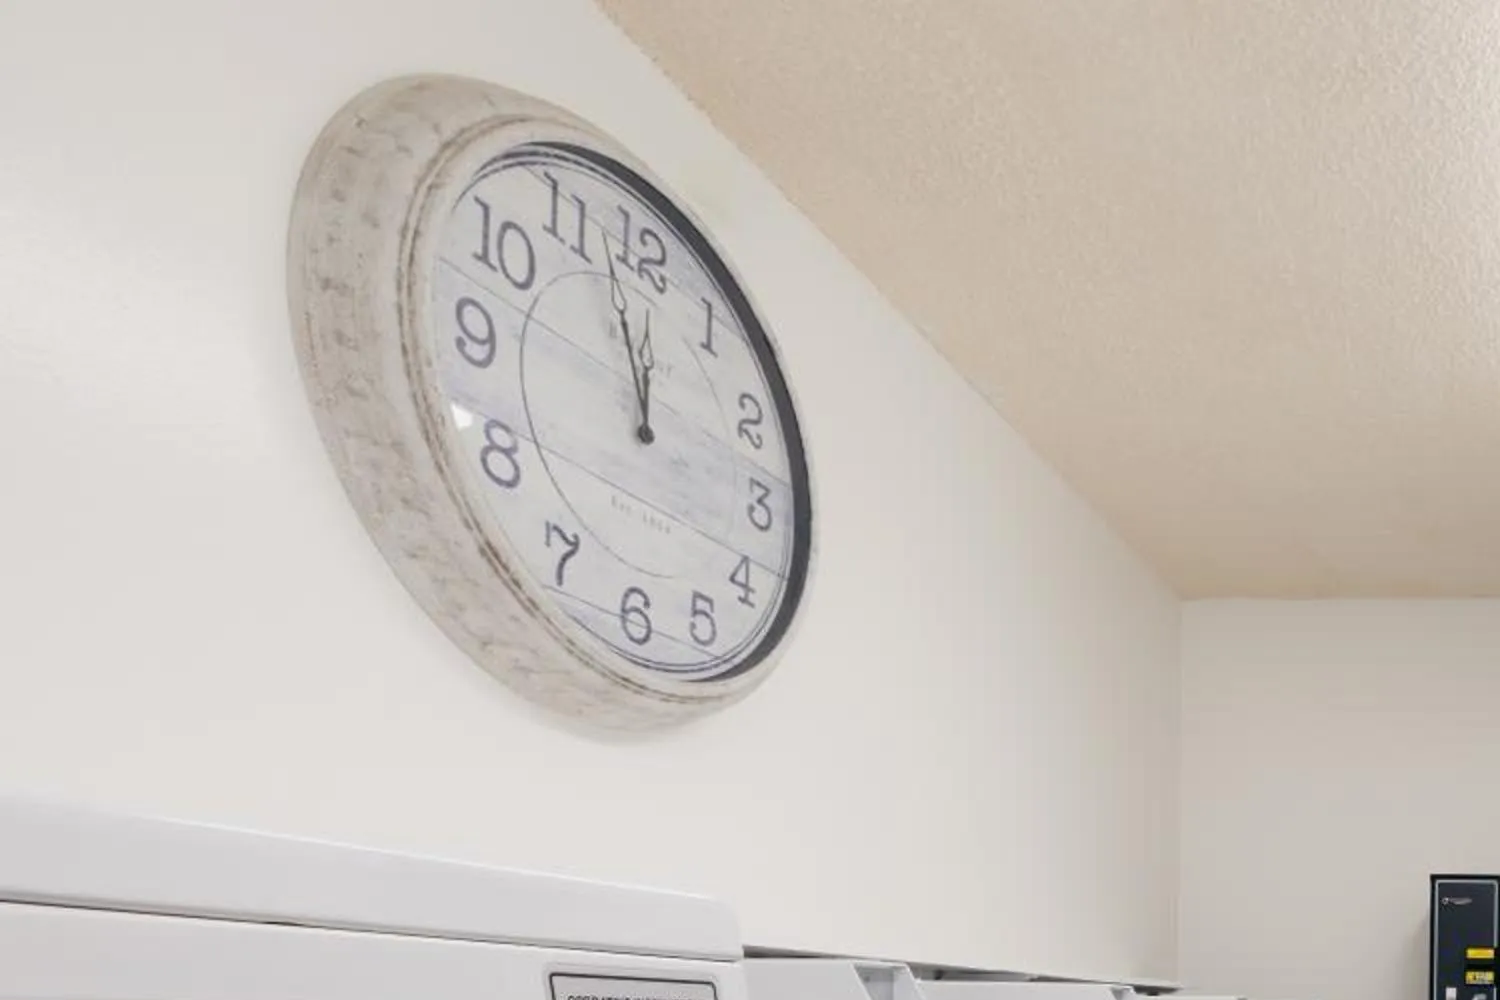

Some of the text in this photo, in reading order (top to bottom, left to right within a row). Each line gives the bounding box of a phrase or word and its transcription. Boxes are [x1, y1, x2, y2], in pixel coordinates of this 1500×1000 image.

[473, 196, 535, 291] 10
[543, 171, 592, 264] 11
[617, 205, 667, 293] 12
[455, 297, 496, 369] 9
[700, 298, 718, 356] 1
[738, 393, 764, 450] 2
[480, 418, 521, 489] 8
[748, 478, 771, 532] 3
[544, 520, 581, 586] 7
[729, 555, 755, 608] 4
[620, 587, 652, 645] 6
[689, 591, 717, 646] 5
